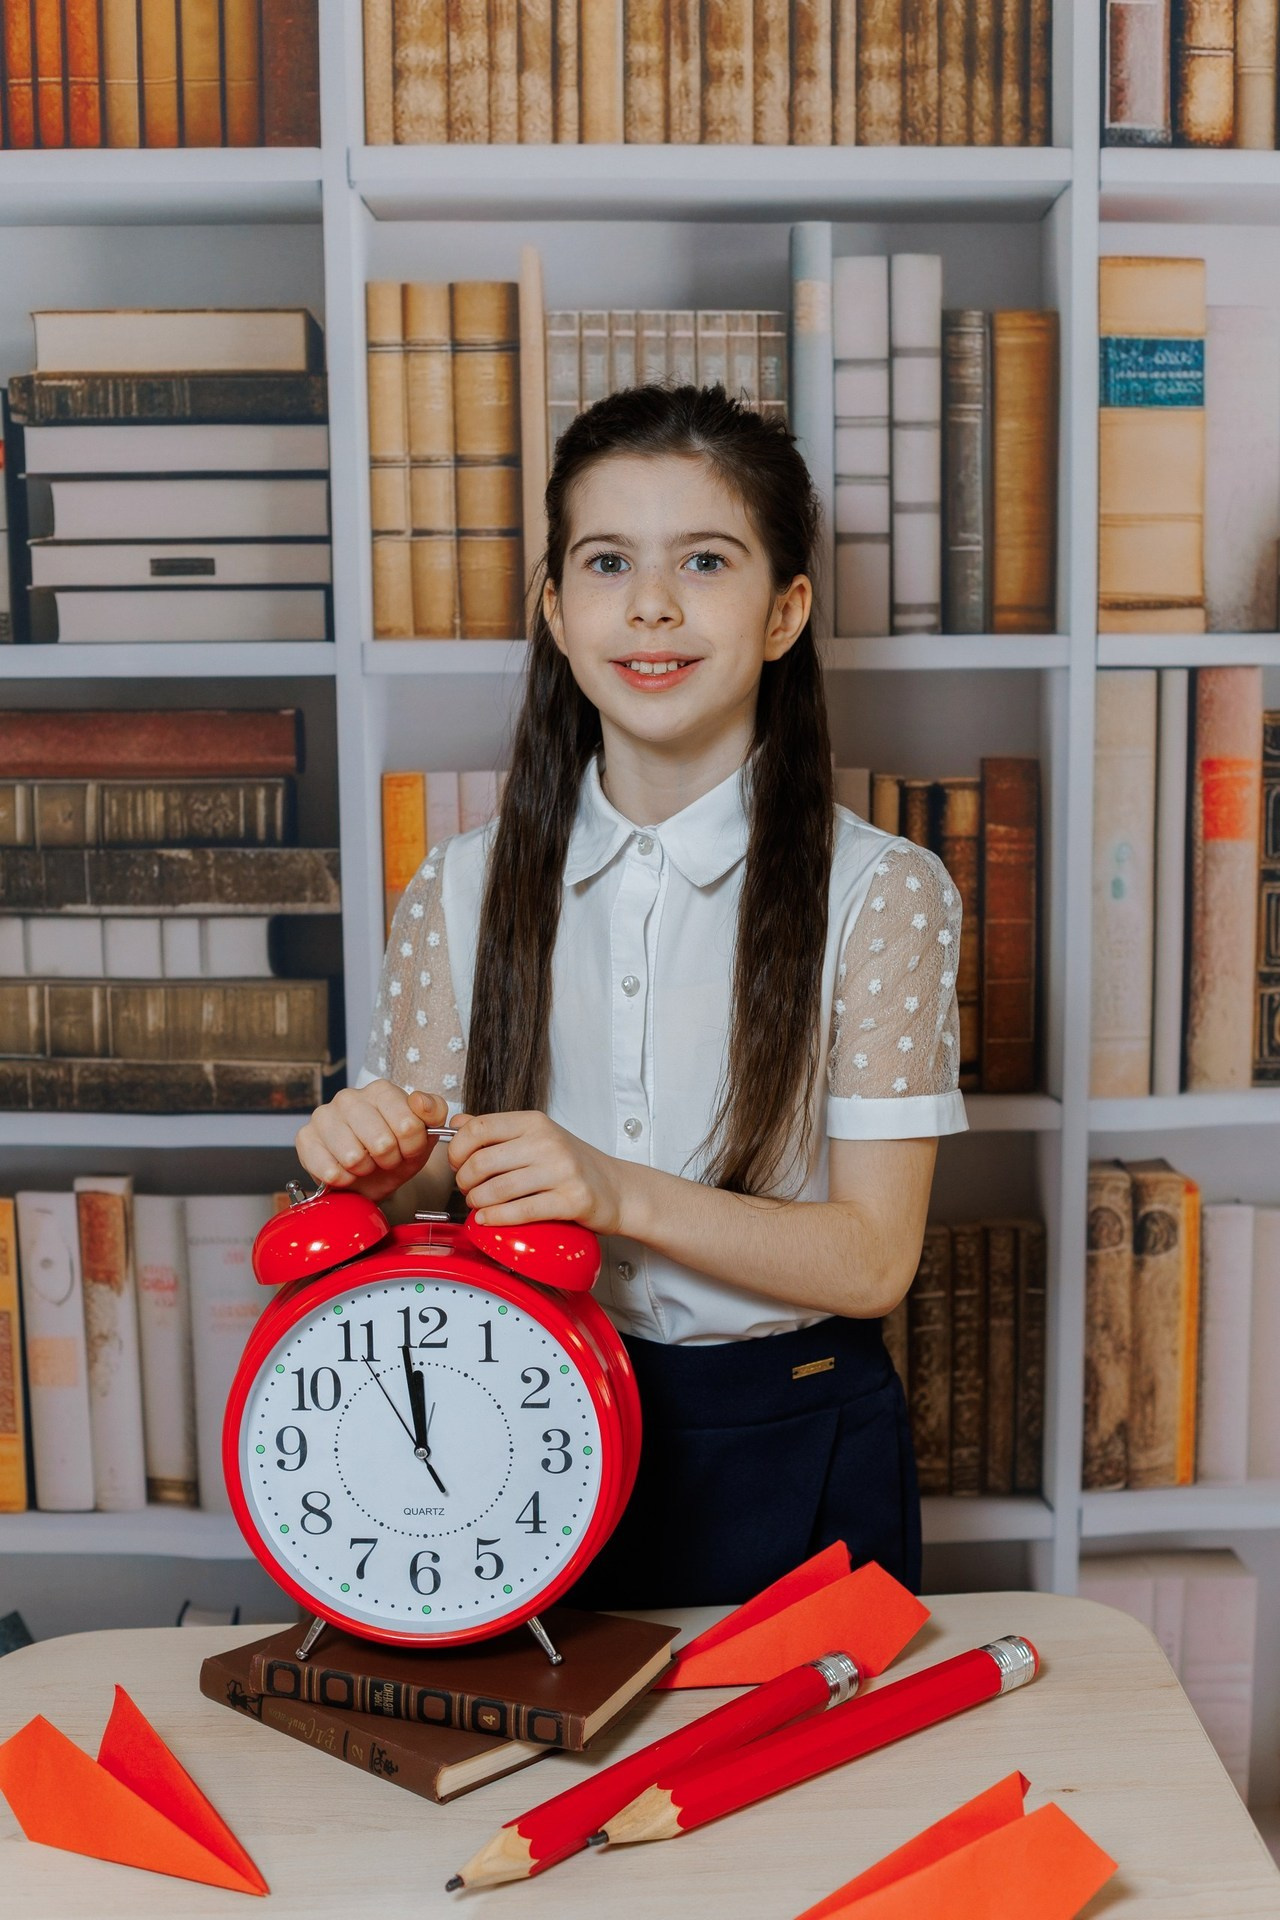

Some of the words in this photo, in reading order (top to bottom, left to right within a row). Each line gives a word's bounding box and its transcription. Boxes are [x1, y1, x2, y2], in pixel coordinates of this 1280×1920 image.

[337, 1319, 381, 1362] 11
[397, 1306, 449, 1349] 12
[478, 1320, 499, 1363] 1
[291, 1366, 342, 1412] 10
[520, 1366, 551, 1409] 2
[275, 1425, 308, 1472] 9
[541, 1428, 573, 1475] 3
[300, 1490, 333, 1535] 8
[403, 1507, 446, 1517] QUARTZ
[515, 1490, 547, 1534] 4
[349, 1537, 379, 1580] 7
[409, 1550, 442, 1596] 6
[474, 1537, 505, 1581] 5
[482, 1714, 496, 1726] 4
